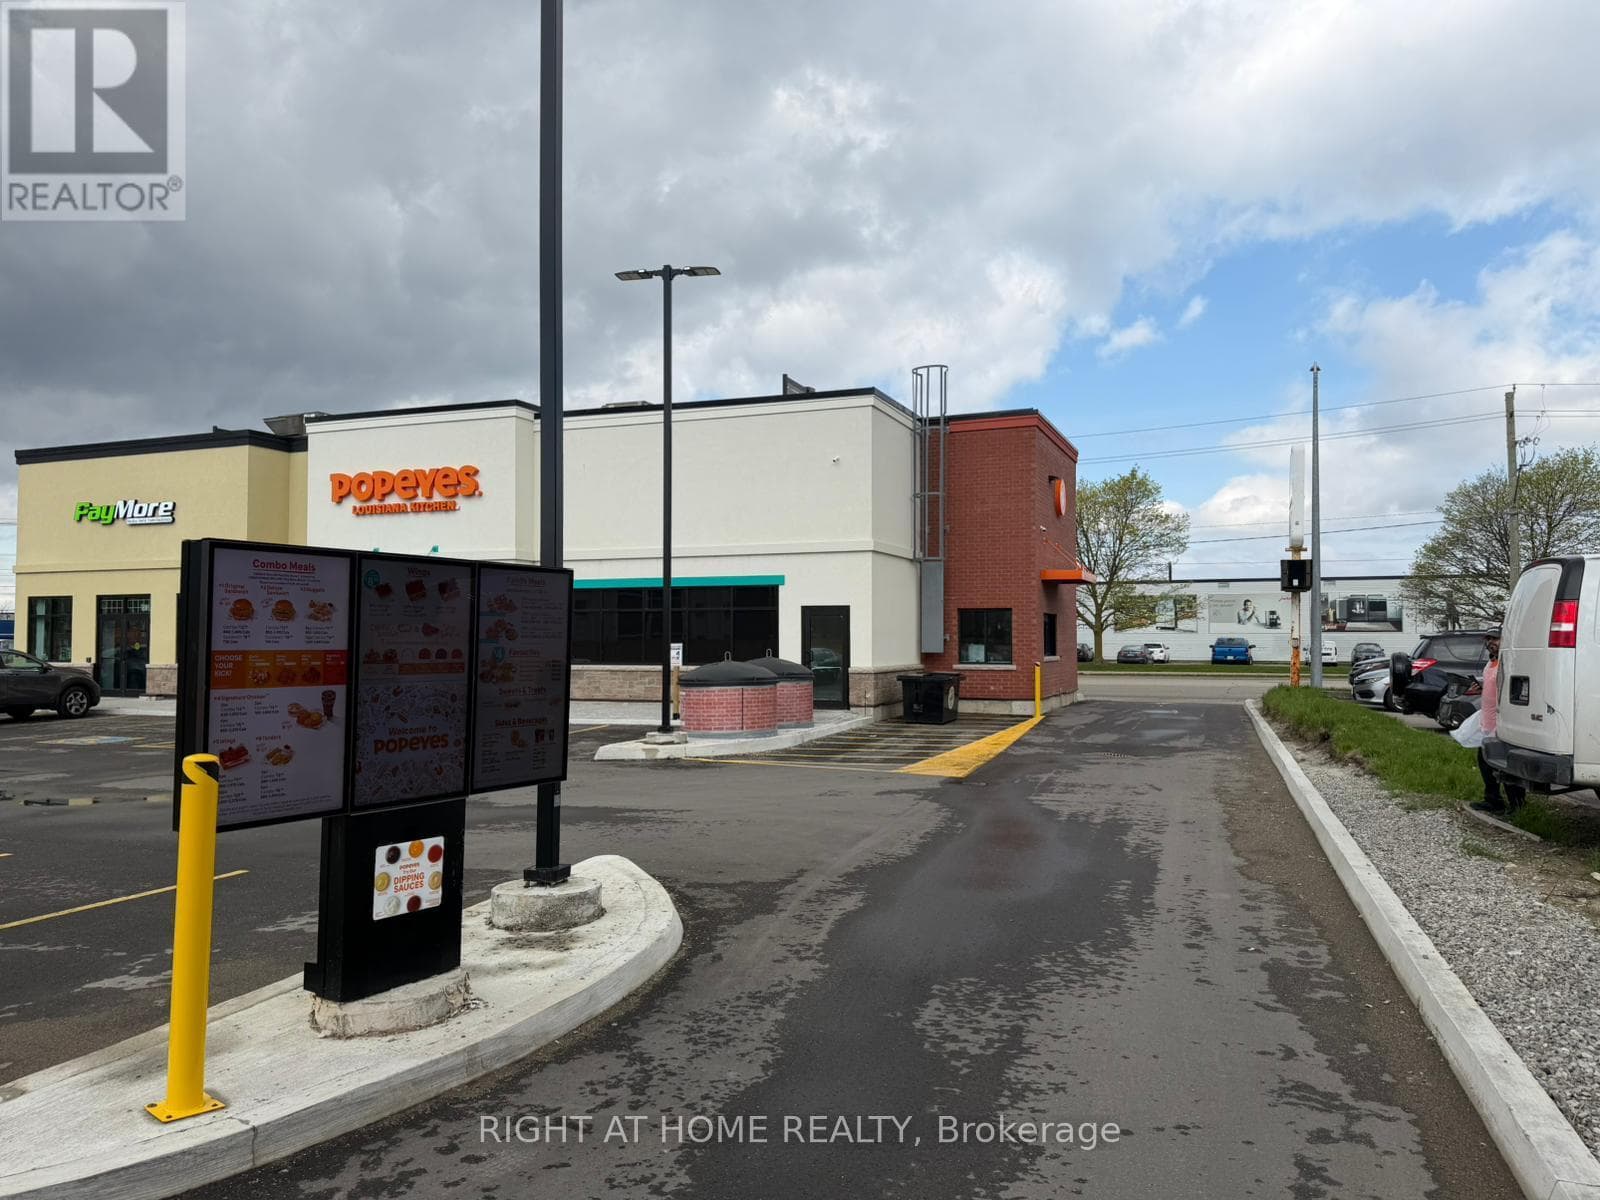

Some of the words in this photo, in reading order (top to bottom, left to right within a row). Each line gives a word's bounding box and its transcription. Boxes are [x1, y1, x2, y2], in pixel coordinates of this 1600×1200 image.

[352, 502, 409, 515] LOUISIANA
[411, 500, 457, 513] KITCHEN
[253, 559, 287, 570] Combo
[289, 560, 317, 572] Meals
[214, 654, 243, 662] CHOOSE
[214, 662, 234, 670] YOUR
[388, 726, 427, 737] Welcome
[428, 724, 438, 734] to
[393, 872, 424, 886] DIPPING
[393, 880, 424, 893] SAUCES
